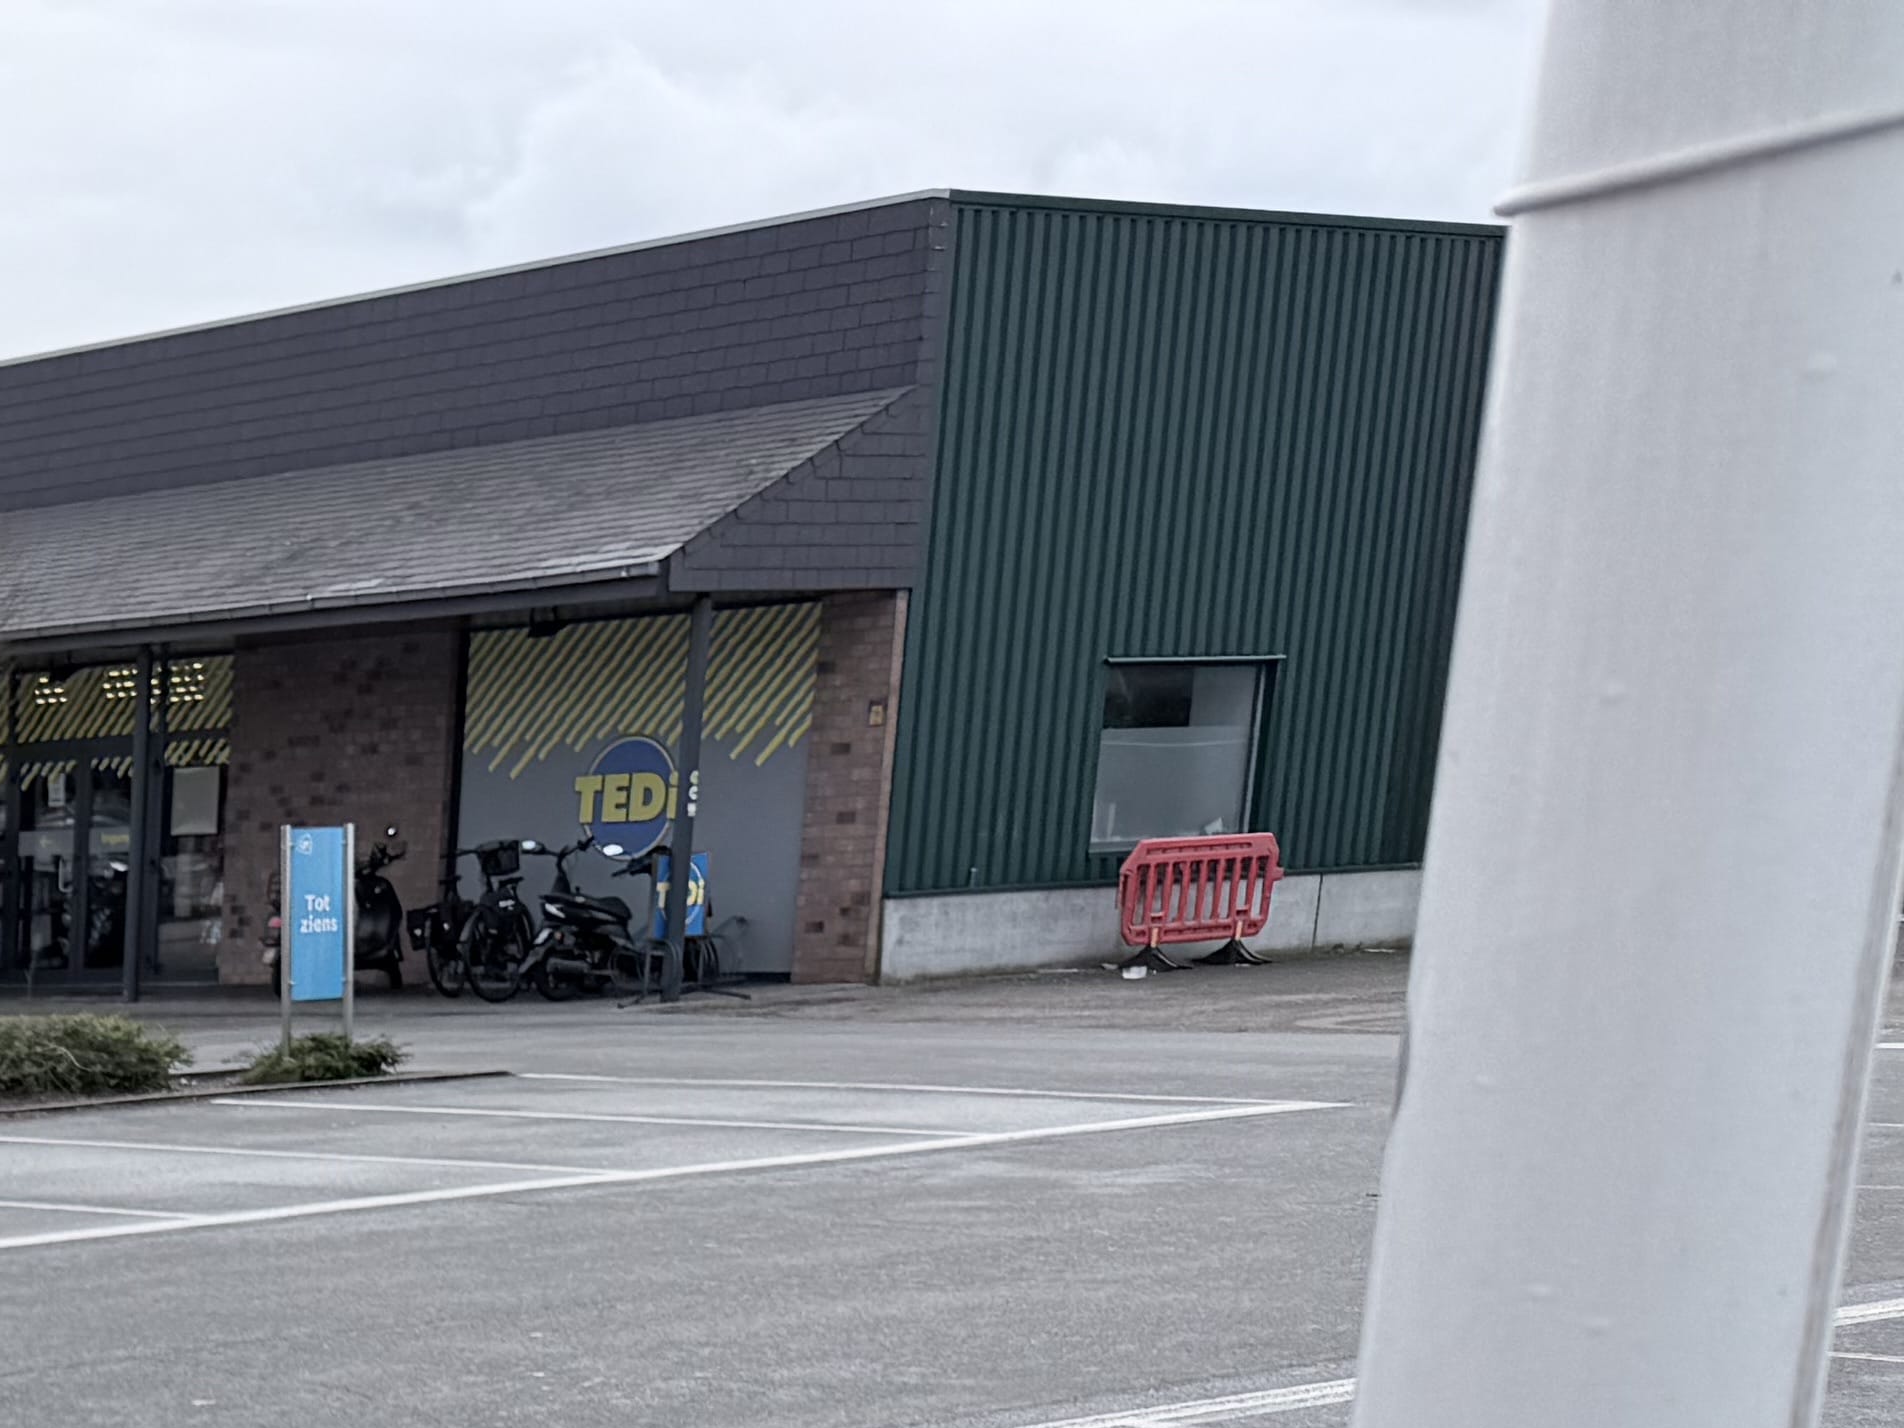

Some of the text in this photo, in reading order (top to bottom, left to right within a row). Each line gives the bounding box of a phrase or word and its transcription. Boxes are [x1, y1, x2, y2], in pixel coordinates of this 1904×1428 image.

[575, 771, 679, 824] TEDi
[304, 894, 331, 912] Tot
[300, 915, 338, 933] ziens
